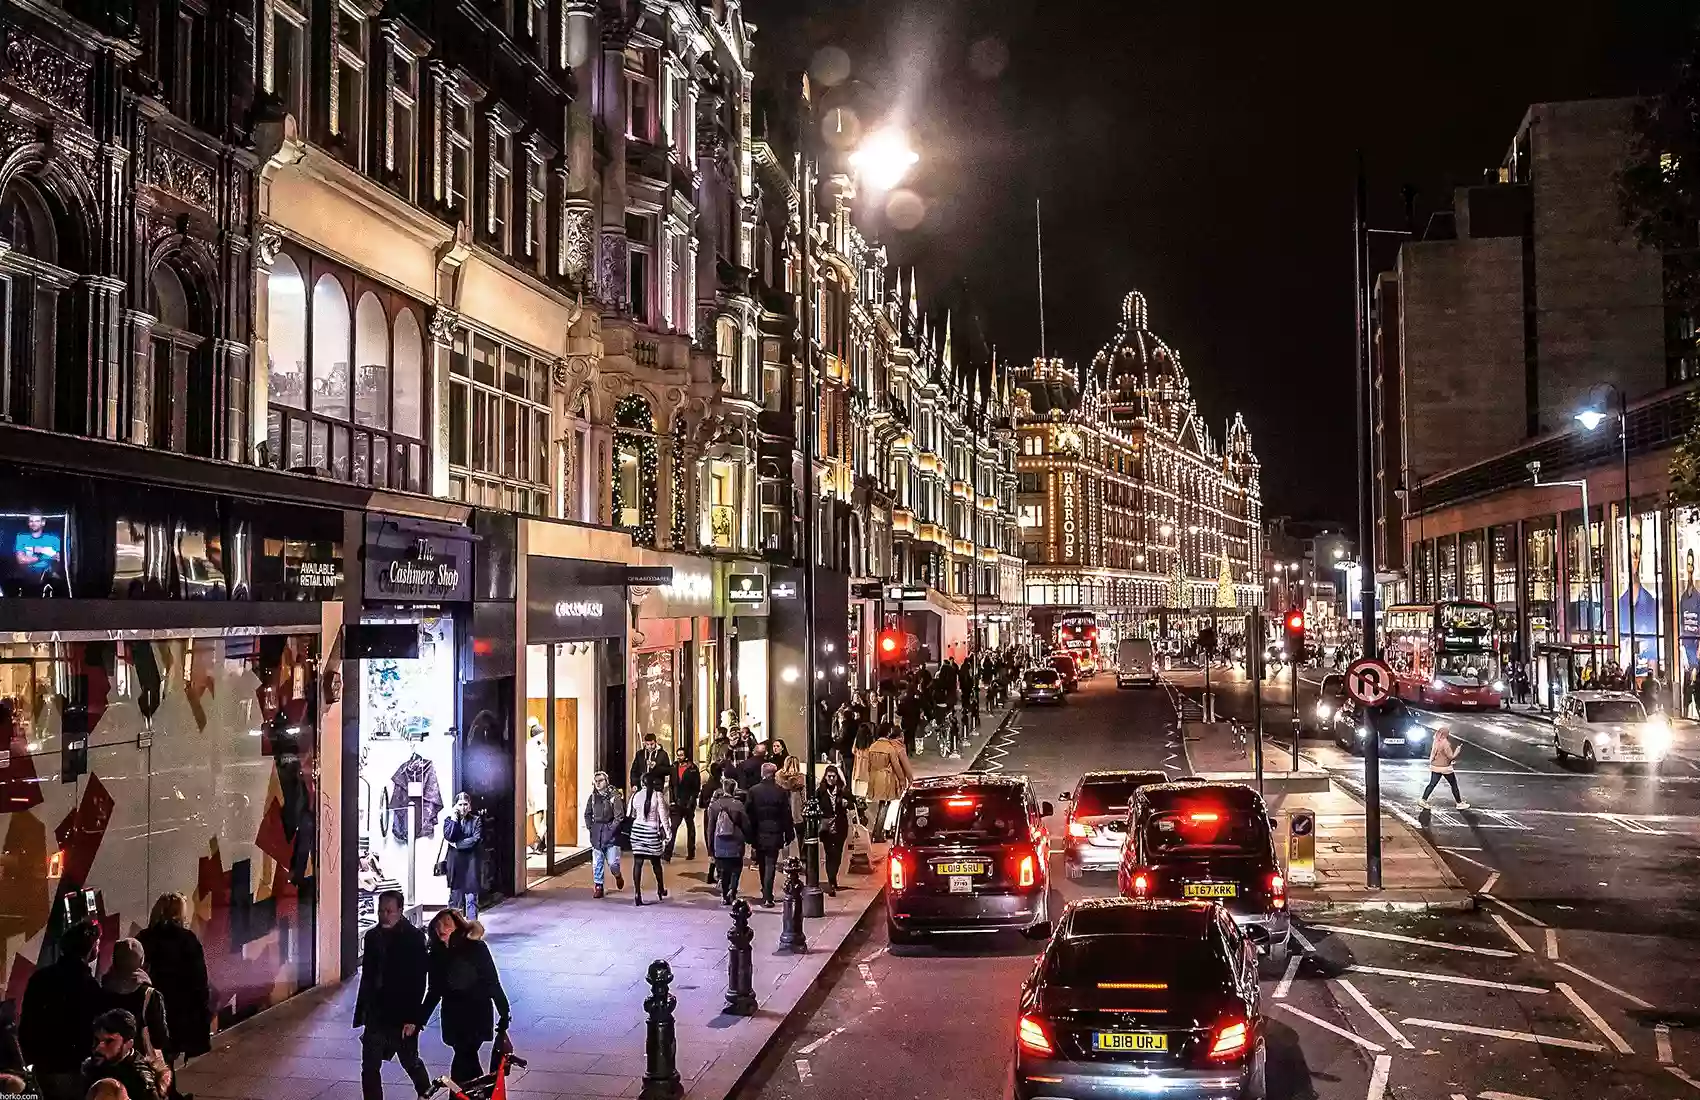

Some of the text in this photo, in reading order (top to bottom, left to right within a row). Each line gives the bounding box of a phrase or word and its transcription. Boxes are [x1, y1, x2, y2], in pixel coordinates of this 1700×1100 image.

[1063, 471, 1075, 558] HARRODS
[416, 538, 434, 561] The
[300, 562, 335, 575] AVAILABLE
[389, 560, 459, 591] Cashmere Shop
[300, 574, 338, 587] RETAIL UNIT
[962, 863, 979, 873] SRU
[1188, 886, 1232, 895] LT67 KRK
[1103, 1034, 1163, 1049] LB18 URJ
